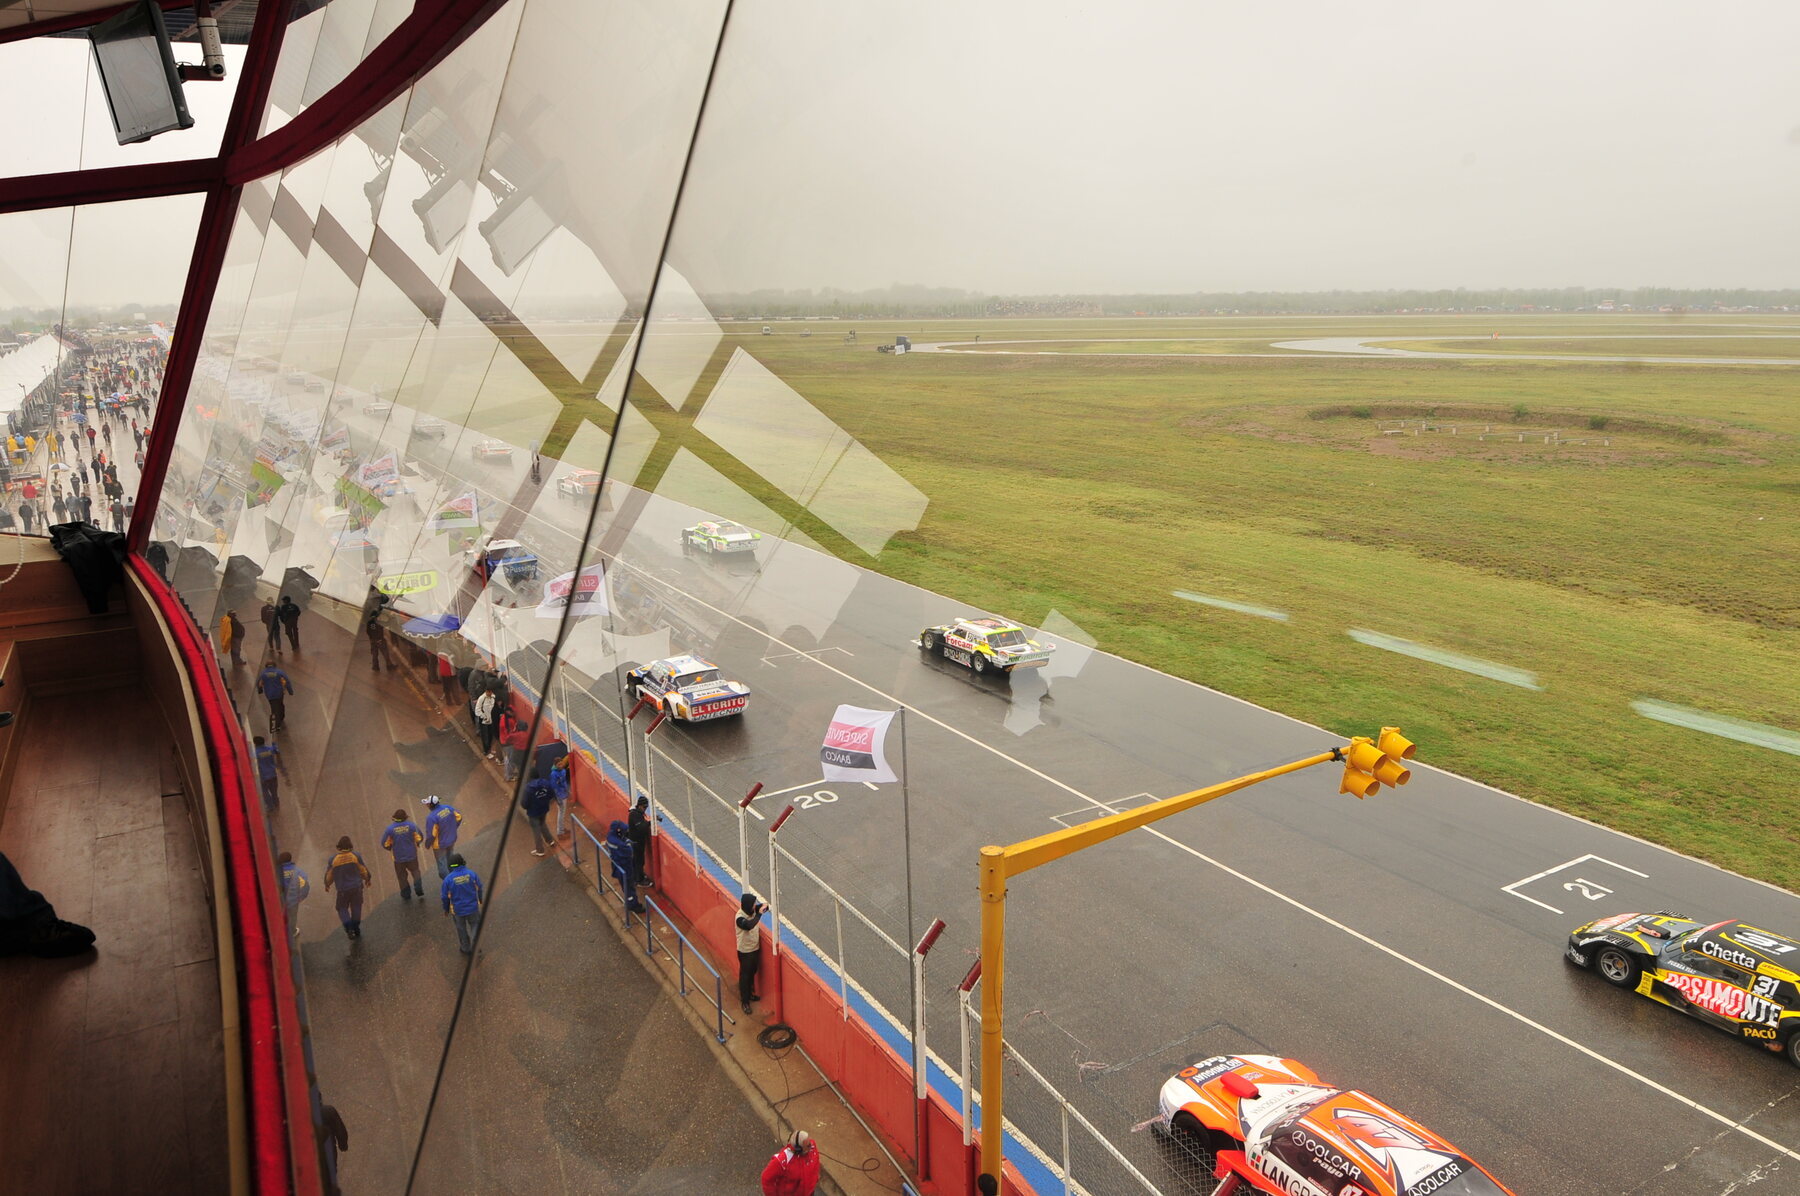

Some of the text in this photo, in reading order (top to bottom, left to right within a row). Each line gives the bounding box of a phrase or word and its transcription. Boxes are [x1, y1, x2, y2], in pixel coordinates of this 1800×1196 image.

[945, 634, 974, 650] Forcam
[692, 697, 745, 715] EL TORITO
[793, 790, 839, 810] 20
[1563, 878, 1615, 901] 21
[1734, 931, 1798, 953] 31
[1702, 941, 1756, 969] Chetta
[1753, 975, 1781, 997] 31
[1743, 1027, 1777, 1039] PACÚ
[1305, 1139, 1362, 1180] COLCAR
[1419, 1162, 1463, 1195] COLCAR
